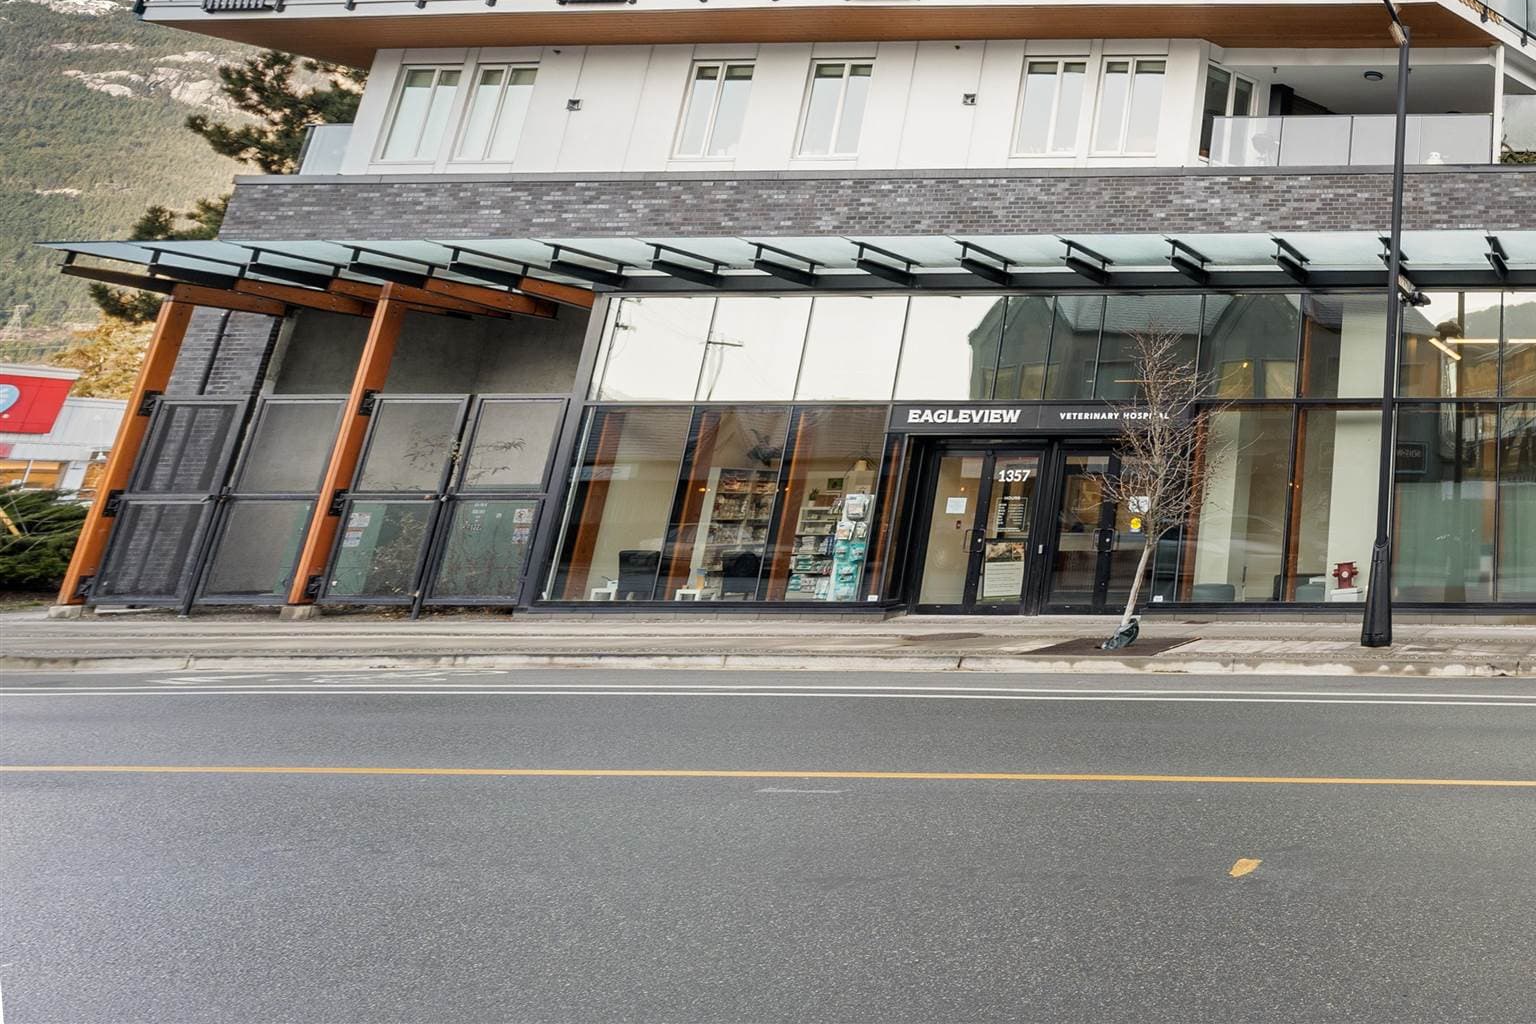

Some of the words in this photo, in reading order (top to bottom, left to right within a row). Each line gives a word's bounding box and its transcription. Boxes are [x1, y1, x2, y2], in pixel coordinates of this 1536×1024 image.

[907, 409, 1022, 424] EAGLEVIEW
[1060, 412, 1120, 420] VETERINARY
[1123, 412, 1170, 420] HOSPIAL
[998, 469, 1031, 483] 1357
